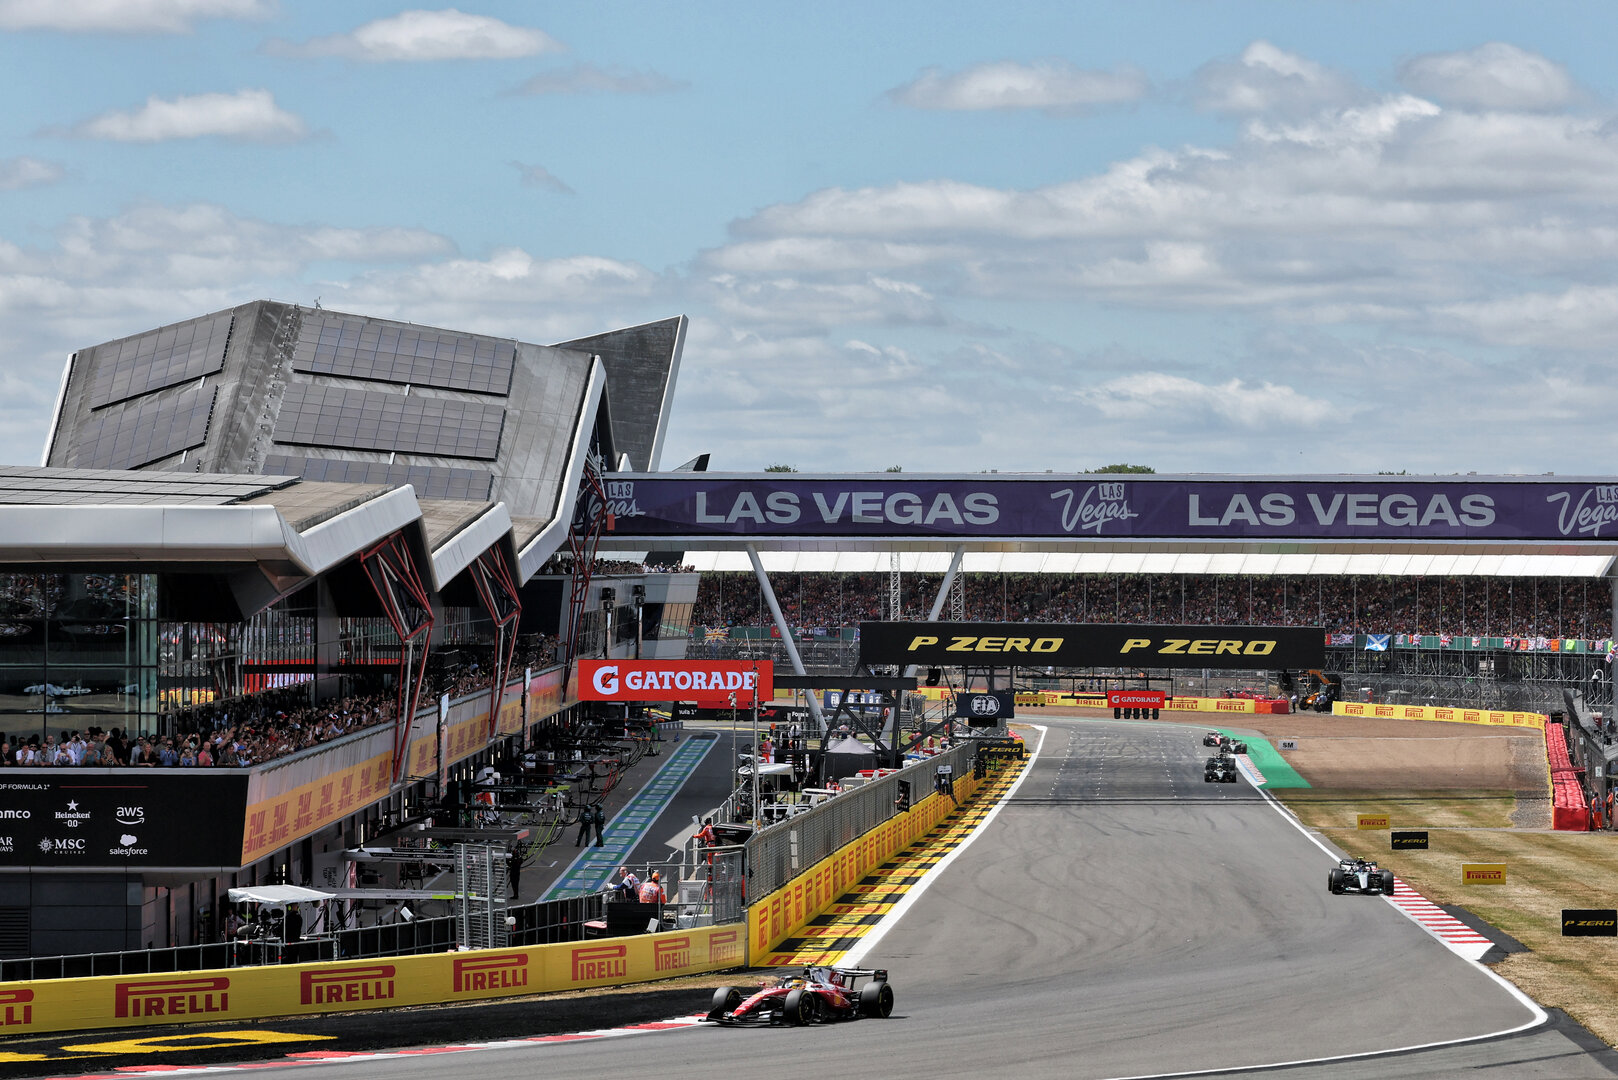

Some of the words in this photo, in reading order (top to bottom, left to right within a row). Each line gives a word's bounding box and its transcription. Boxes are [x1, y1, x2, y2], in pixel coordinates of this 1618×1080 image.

[610, 484, 632, 498] LAS
[1100, 484, 1123, 499] LAS
[696, 491, 801, 524] LAS
[812, 491, 1000, 525] VEGAS
[1050, 486, 1139, 534] Vegas
[1188, 493, 1296, 526] LAS
[1306, 493, 1496, 527] VEGAS
[1546, 488, 1618, 537] Vega
[908, 636, 939, 651] P
[946, 636, 1065, 653] ZERO
[1120, 639, 1150, 654] P
[1158, 639, 1277, 655] ZERO
[625, 671, 756, 690] GATORADE
[973, 699, 997, 713] FIA
[1169, 700, 1198, 709] PIRELLI
[1216, 701, 1245, 711] PIRELLI
[116, 806, 144, 817] aws
[1360, 818, 1387, 826] PIRELLI
[54, 838, 86, 850] MSC
[109, 846, 148, 856] salesforce
[1466, 871, 1501, 879] PIRELLI
[654, 936, 690, 971] PIRELLI
[571, 944, 627, 981] PIRELLI
[453, 953, 529, 992] PIRELLI
[300, 965, 396, 1005] PIRELLI
[115, 977, 230, 1018] PIRELLI
